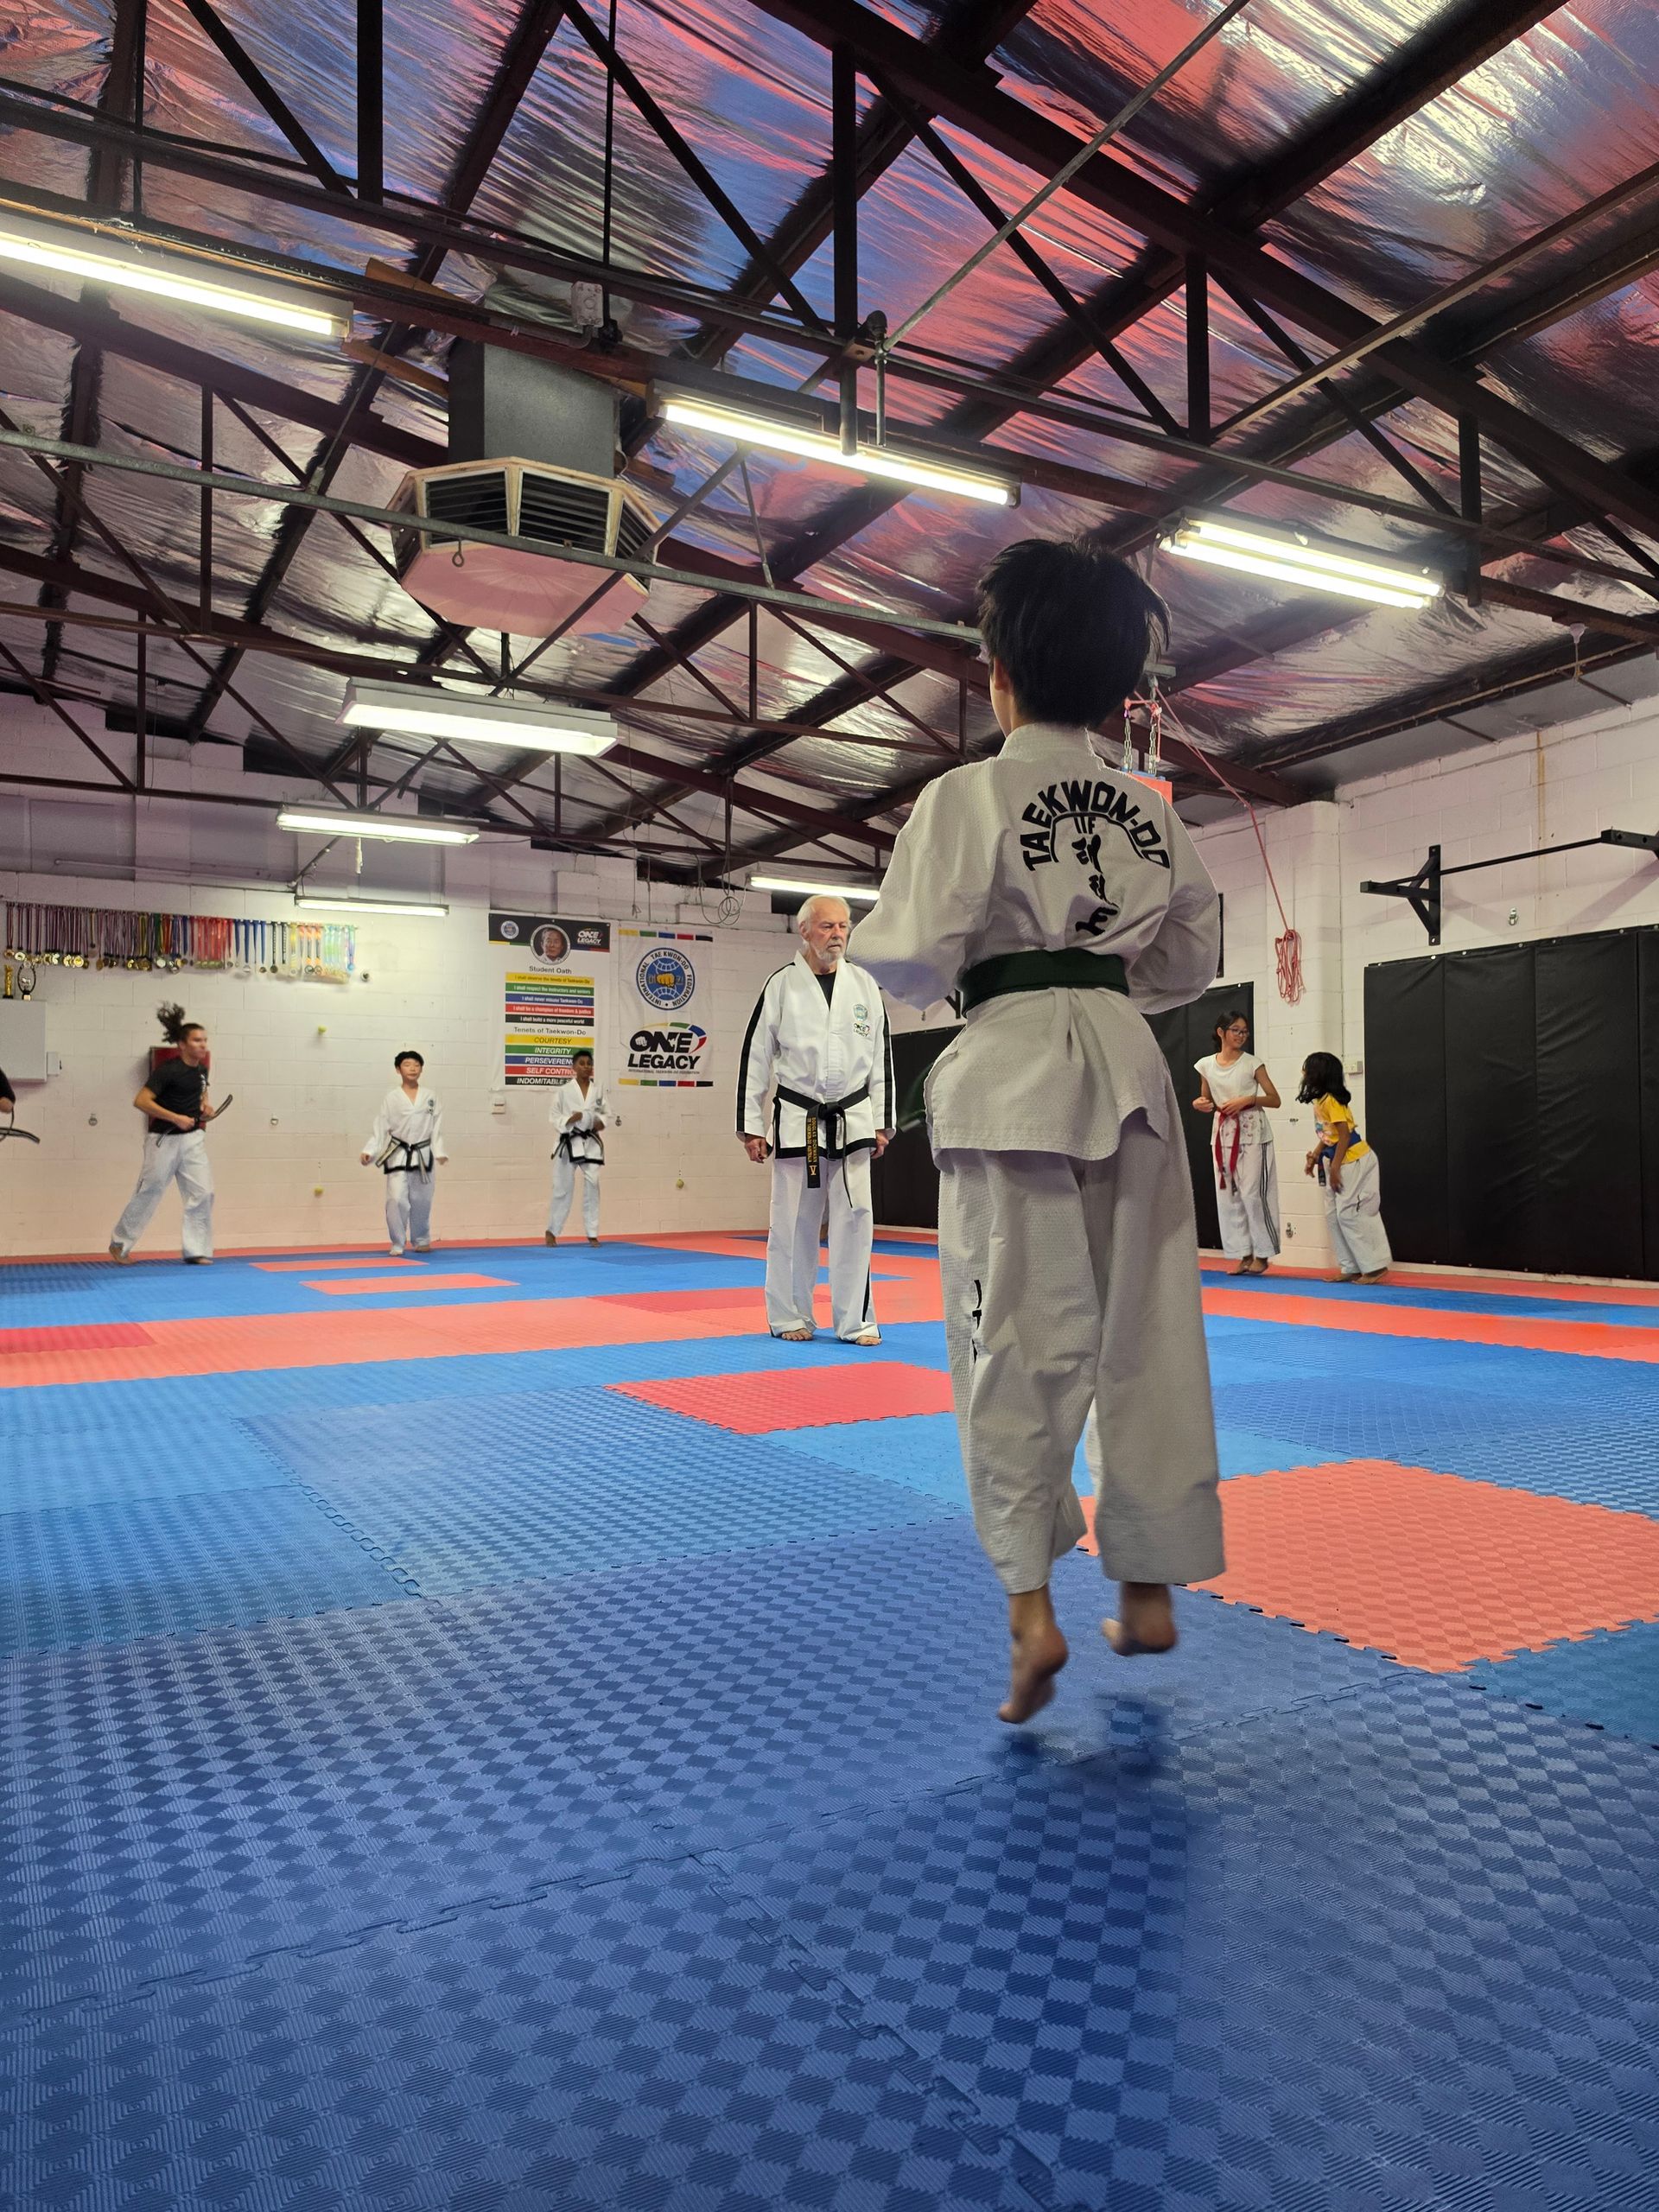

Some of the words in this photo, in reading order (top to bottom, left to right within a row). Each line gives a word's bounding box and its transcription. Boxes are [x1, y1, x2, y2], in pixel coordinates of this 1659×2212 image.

[1020, 779, 1171, 872] TAEKWON-DO
[639, 962, 662, 1006] INTERNATIONAL
[672, 974, 693, 1007] FEDERATION
[630, 1030, 693, 1053] ONE
[627, 1053, 701, 1070] LEGACY
